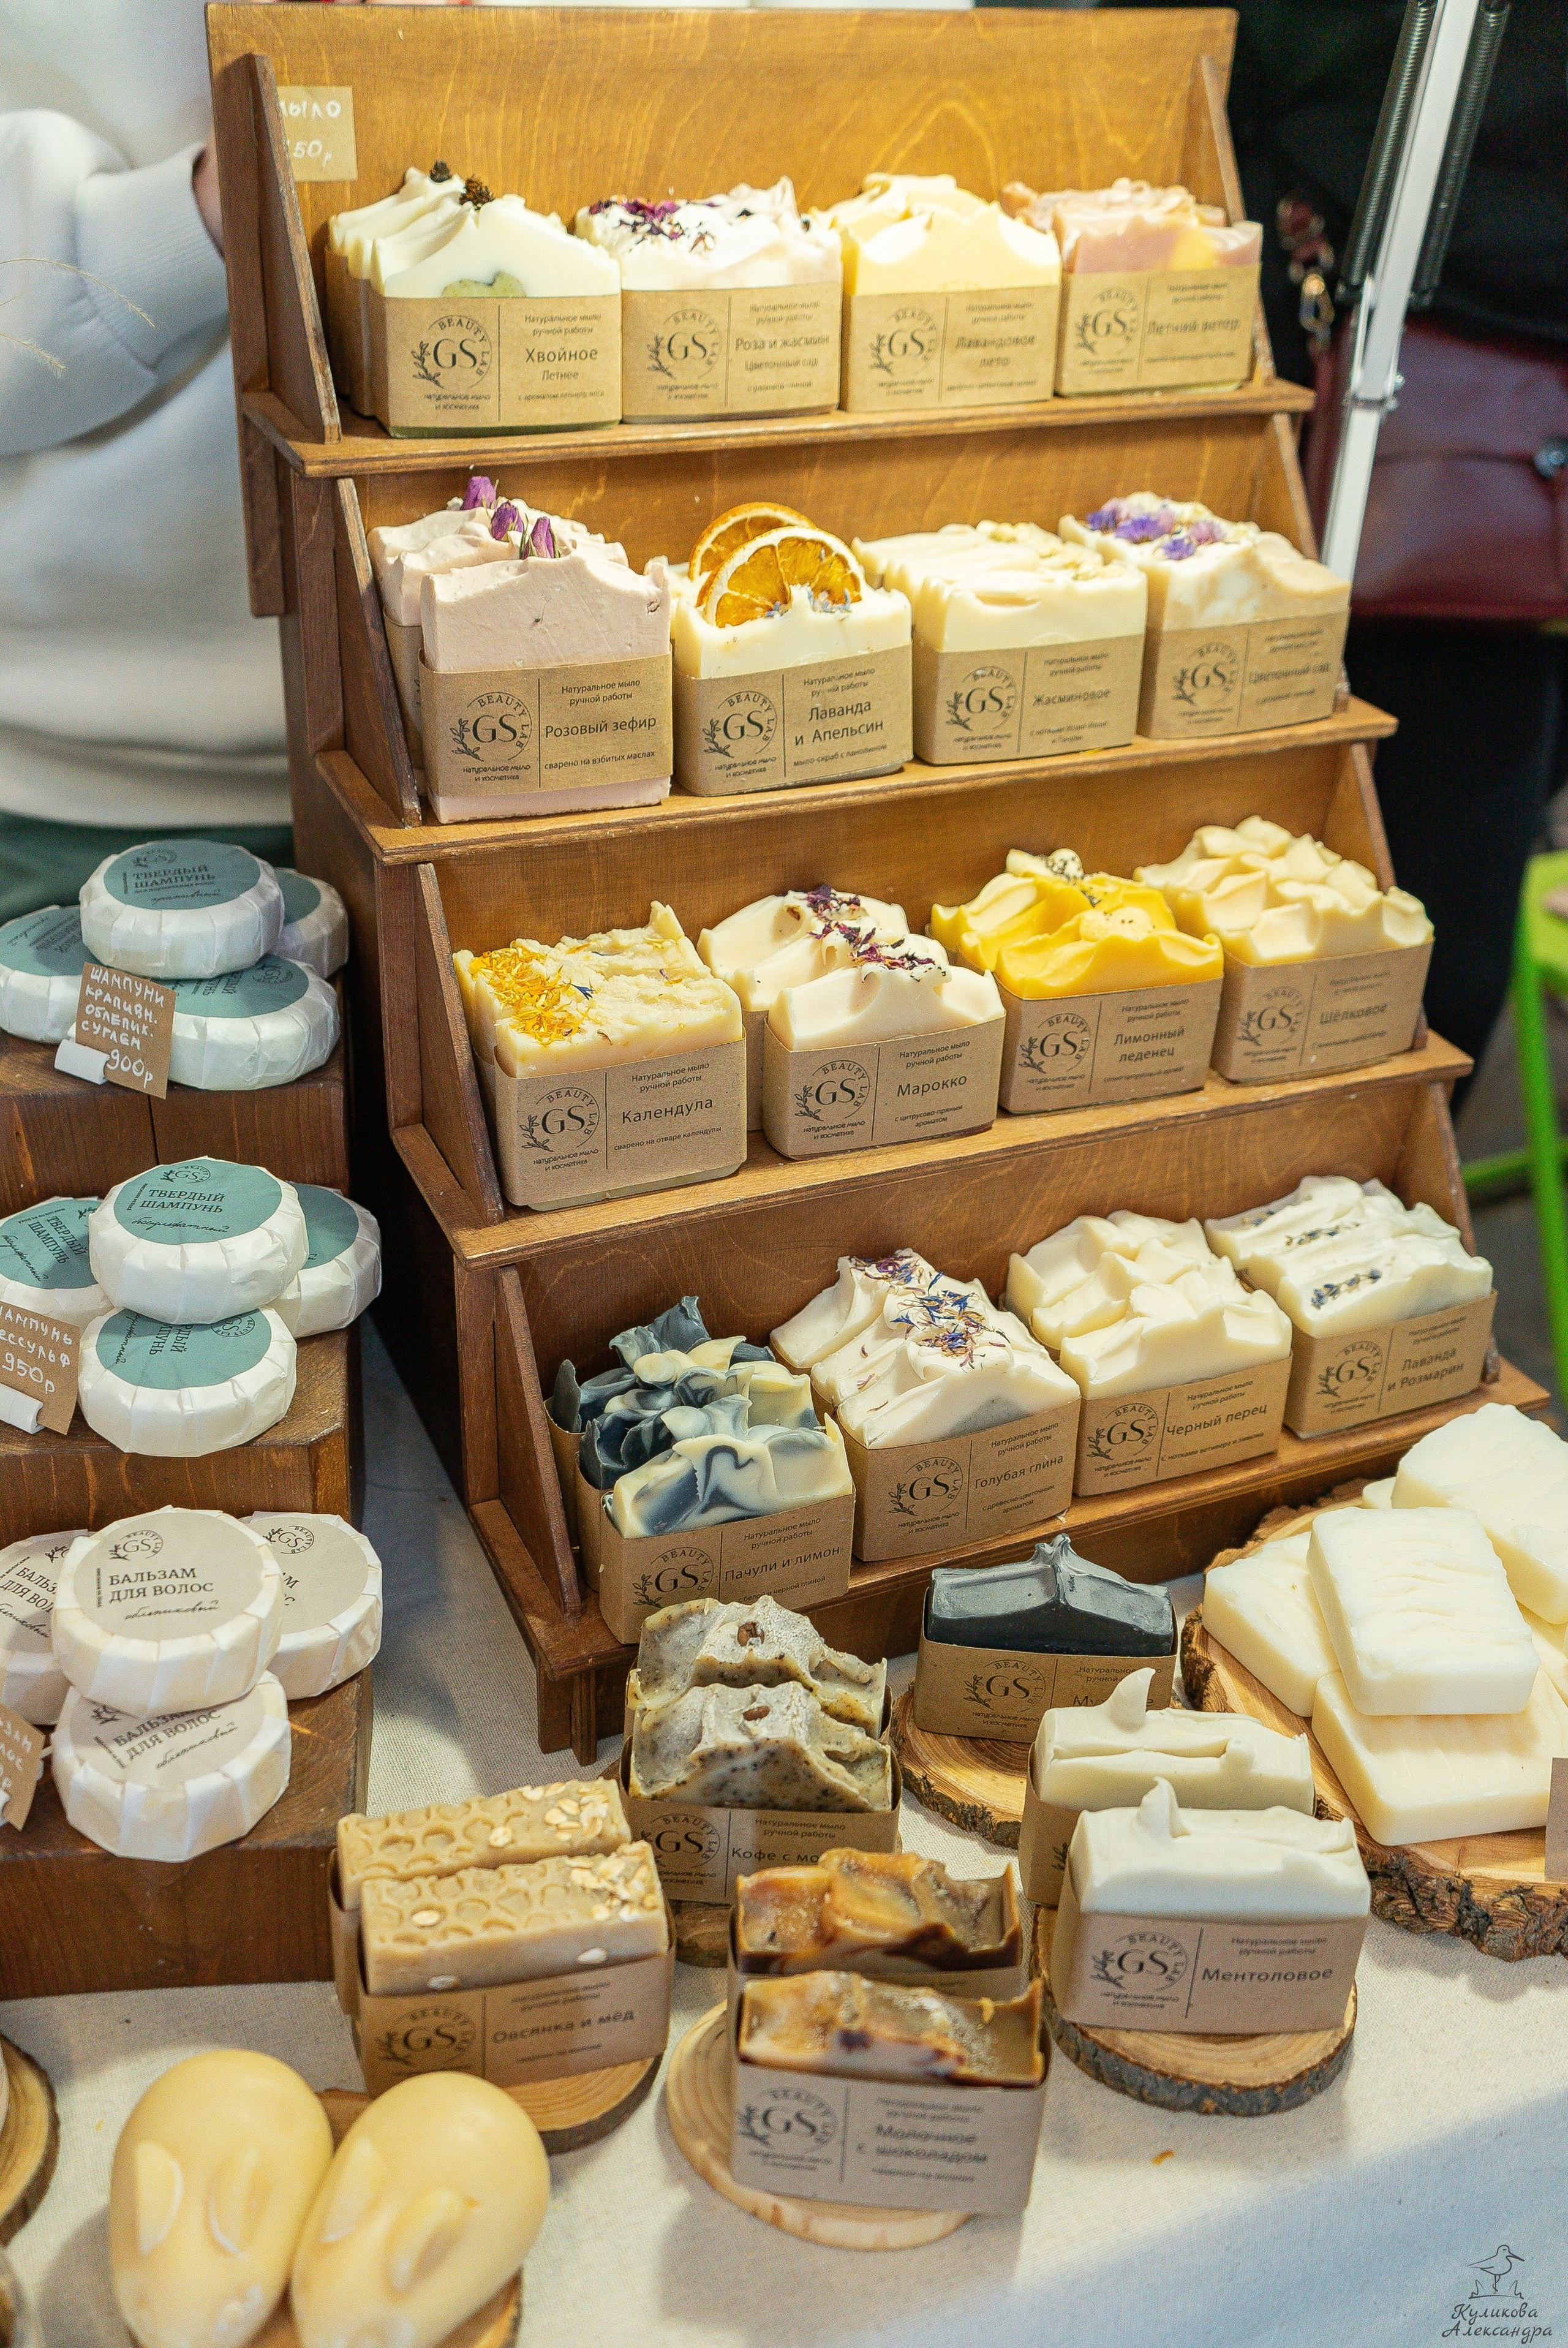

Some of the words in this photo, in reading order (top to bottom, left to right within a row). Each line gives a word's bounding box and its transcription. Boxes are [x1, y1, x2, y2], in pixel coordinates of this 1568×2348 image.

[287, 140, 333, 168] 50р
[1092, 308, 1128, 337] GS
[433, 338, 477, 369] GS
[526, 345, 597, 363] Хвойное
[667, 332, 707, 360] GS
[736, 338, 766, 350] Роза
[768, 338, 778, 349] и
[779, 335, 830, 348] жасмин
[888, 328, 924, 357] GS
[542, 370, 579, 381] Летнее
[562, 682, 616, 694] Натуральное
[618, 679, 640, 689] мыло
[804, 673, 853, 687] Натуральное
[854, 667, 875, 678] мыло
[1191, 660, 1226, 689] GS
[570, 694, 600, 706] ручной
[603, 692, 633, 703] работы
[966, 685, 1003, 714] GS
[1033, 689, 1111, 706] Жасминовое
[478, 695, 528, 718] BEAUTY
[515, 724, 530, 748] LAB
[809, 701, 871, 722] Лаванда
[472, 714, 518, 743] GS
[546, 720, 608, 738] Розовый
[611, 716, 657, 732] зефир
[723, 710, 764, 741] GS
[795, 734, 804, 746] и
[812, 720, 884, 744] Апельсин
[545, 759, 578, 770] сварено
[592, 753, 625, 765] взбитых
[627, 750, 655, 760] маслах
[132, 864, 208, 880] ТВЕРДЫЙ
[134, 874, 215, 888] ШАМПУНЬ
[91, 967, 164, 1008] ШАМПУНИ
[1257, 1005, 1292, 1032] GS
[1039, 1030, 1078, 1057] GS
[1114, 1026, 1185, 1046] Лимонный
[899, 1046, 949, 1059] Натуральное
[951, 1040, 970, 1050] мыло
[906, 1058, 934, 1069] ручной
[935, 1052, 963, 1063] работы
[1119, 1047, 1175, 1062] леденец
[631, 1068, 685, 1083] Натуральное
[687, 1062, 710, 1073] мыло
[639, 1082, 671, 1093] ручной
[672, 1075, 702, 1087] работы
[815, 1078, 856, 1105] GS
[897, 1076, 967, 1097] Марокко
[541, 1104, 586, 1134] GS
[546, 1089, 596, 1108] BEAUTY
[584, 1112, 598, 1136] LAB
[622, 1098, 714, 1124] Календула
[915, 1117, 948, 1128] ароматом
[614, 1140, 644, 1151] сварено
[657, 1133, 681, 1145] отваре
[683, 1125, 722, 1139] календулы
[175, 1171, 198, 1180] GS
[140, 1200, 223, 1213] ШАМПУНЬ
[148, 1188, 226, 1202] ТВЕРДЫЙ
[47, 1215, 89, 1255] ТВЕРДЫЙ
[131, 1217, 230, 1233] бессульфатный
[28, 1221, 69, 1264] ШАМПУНЬ
[222, 1317, 242, 1331] GS
[170, 1325, 194, 1353] РДЫЙ
[1336, 1356, 1370, 1383] GS
[1403, 1348, 1457, 1371] Лаванда
[2, 1352, 55, 1394] 950р
[1387, 1383, 1396, 1392] и
[1400, 1363, 1464, 1387] Розмарин
[1188, 1386, 1233, 1401] Натуральное
[1234, 1380, 1254, 1389] мыло
[1219, 1391, 1246, 1403] работы
[1107, 1419, 1146, 1445] GS
[1166, 1415, 1223, 1436] Черный
[1225, 1405, 1268, 1424] перец
[991, 1430, 1038, 1448] Натуральное
[1039, 1422, 1059, 1433] мыло
[997, 1443, 1024, 1457] ручной
[1025, 1435, 1052, 1448] работы
[916, 1459, 960, 1474] BEAUTY
[947, 1478, 962, 1500] LAB
[974, 1468, 1025, 1489] Голубая
[1029, 1455, 1064, 1474] глина
[909, 1473, 949, 1500] GS
[987, 1484, 1055, 1510] древесно-цветочным
[1003, 1500, 1034, 1515] ароматом
[279, 1532, 304, 1547] GS
[295, 1527, 312, 1546] BEAUTY
[744, 1524, 797, 1541] Натуральное
[799, 1517, 821, 1528] мыло
[751, 1539, 782, 1550] ручной
[783, 1530, 813, 1544] работы
[123, 1538, 152, 1552] GS
[110, 1568, 197, 1585] БАЛЬЗАМ
[725, 1561, 777, 1583] Пачули
[782, 1559, 791, 1568] и
[794, 1546, 840, 1566] лимон
[15, 1567, 58, 1594] БАЛЬЗ
[655, 1564, 699, 1593] GS
[0, 1580, 31, 1598] ДЛЯ
[26, 1593, 54, 1612] ВОЛ
[109, 1587, 147, 1604] ДЛЯ
[153, 1582, 214, 1596] ВОЛОС
[124, 1600, 219, 1620] облепиховый
[986, 1675, 1030, 1699] GS
[114, 1710, 195, 1746] БАЛЬЗА
[126, 1734, 164, 1761] ДЛЯ
[162, 1710, 221, 1738] ВОЛОС
[157, 1721, 238, 1770] облепиховый
[755, 1818, 818, 1829] Натуральное
[820, 1822, 846, 1831] мыло
[764, 1829, 799, 1838] ручной
[801, 1830, 836, 1839] работы
[655, 1830, 704, 1854] GS
[732, 1847, 776, 1862] Кофе
[782, 1852, 791, 1861] с
[1118, 1949, 1170, 1976] GS
[1202, 1966, 1334, 1982] Ментоловое
[403, 2024, 456, 2052] GS
[491, 2022, 574, 2045] Овсянка
[581, 2019, 592, 2028] и
[598, 2009, 635, 2026] мёд
[761, 2106, 817, 2136] GS
[875, 2124, 977, 2143] Молочное
